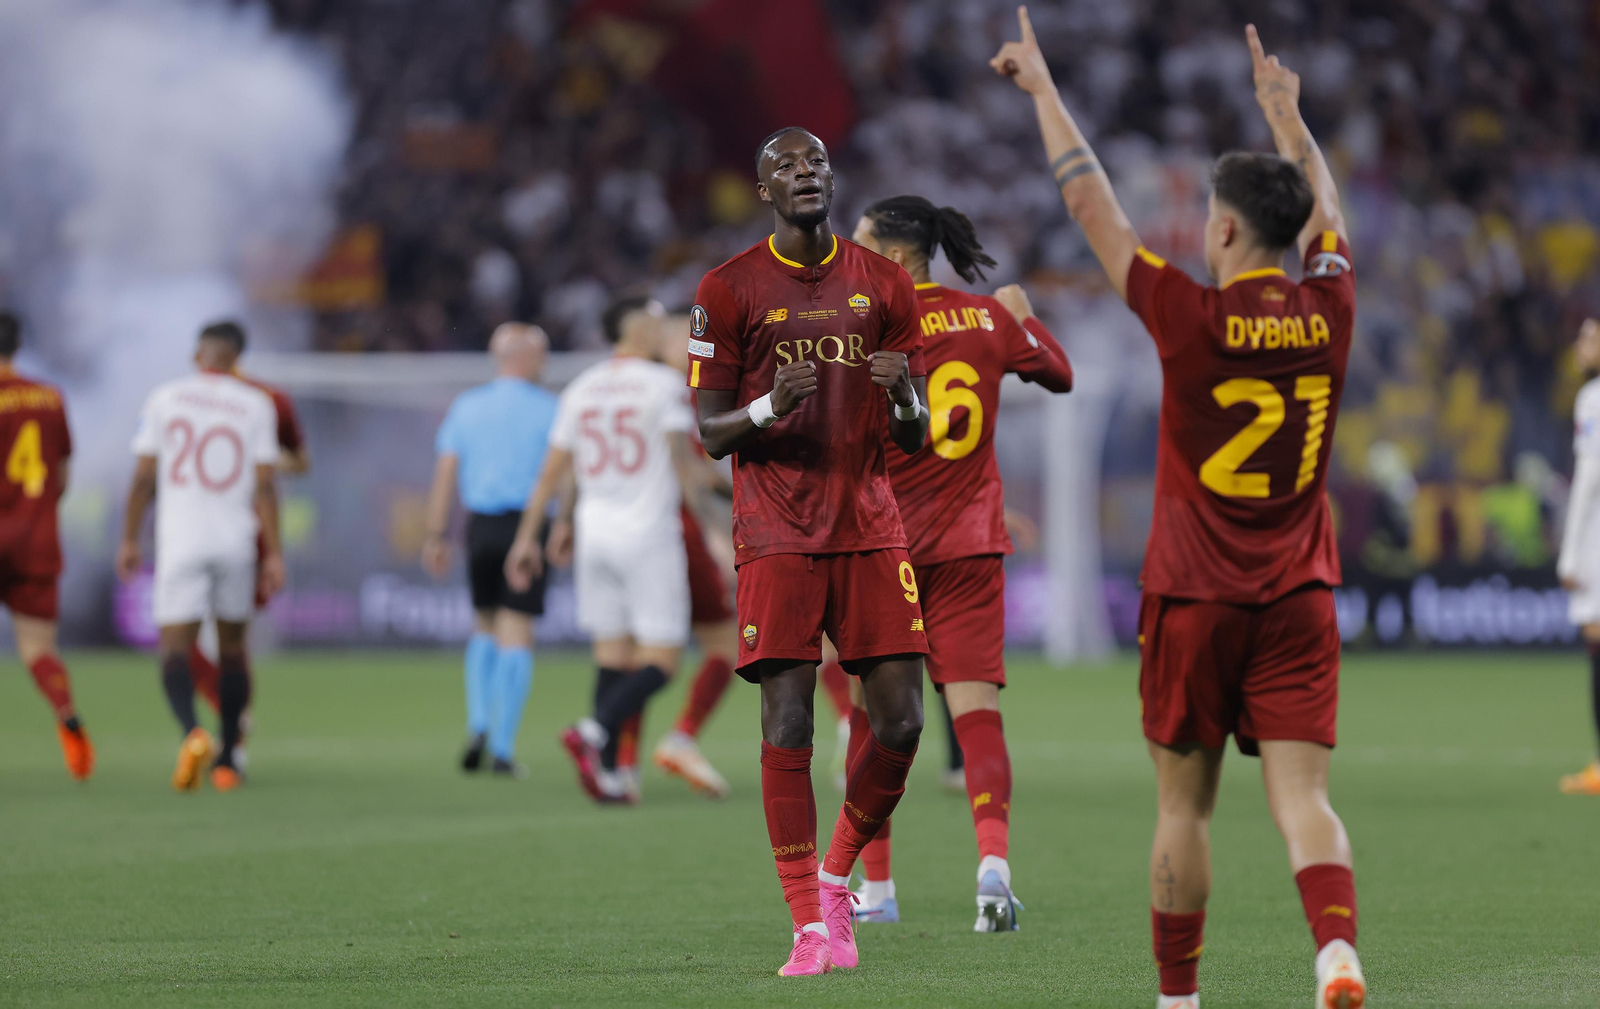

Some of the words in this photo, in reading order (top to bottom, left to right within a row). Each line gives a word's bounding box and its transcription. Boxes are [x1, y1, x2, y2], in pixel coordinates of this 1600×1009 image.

[775, 333, 870, 369] SPQR
[1226, 313, 1330, 349] DYBALA
[578, 407, 647, 477] 55
[927, 360, 983, 460] 6
[1199, 375, 1332, 498] 21
[5, 419, 48, 498] 4
[164, 417, 244, 493] 20
[898, 560, 918, 604] 9
